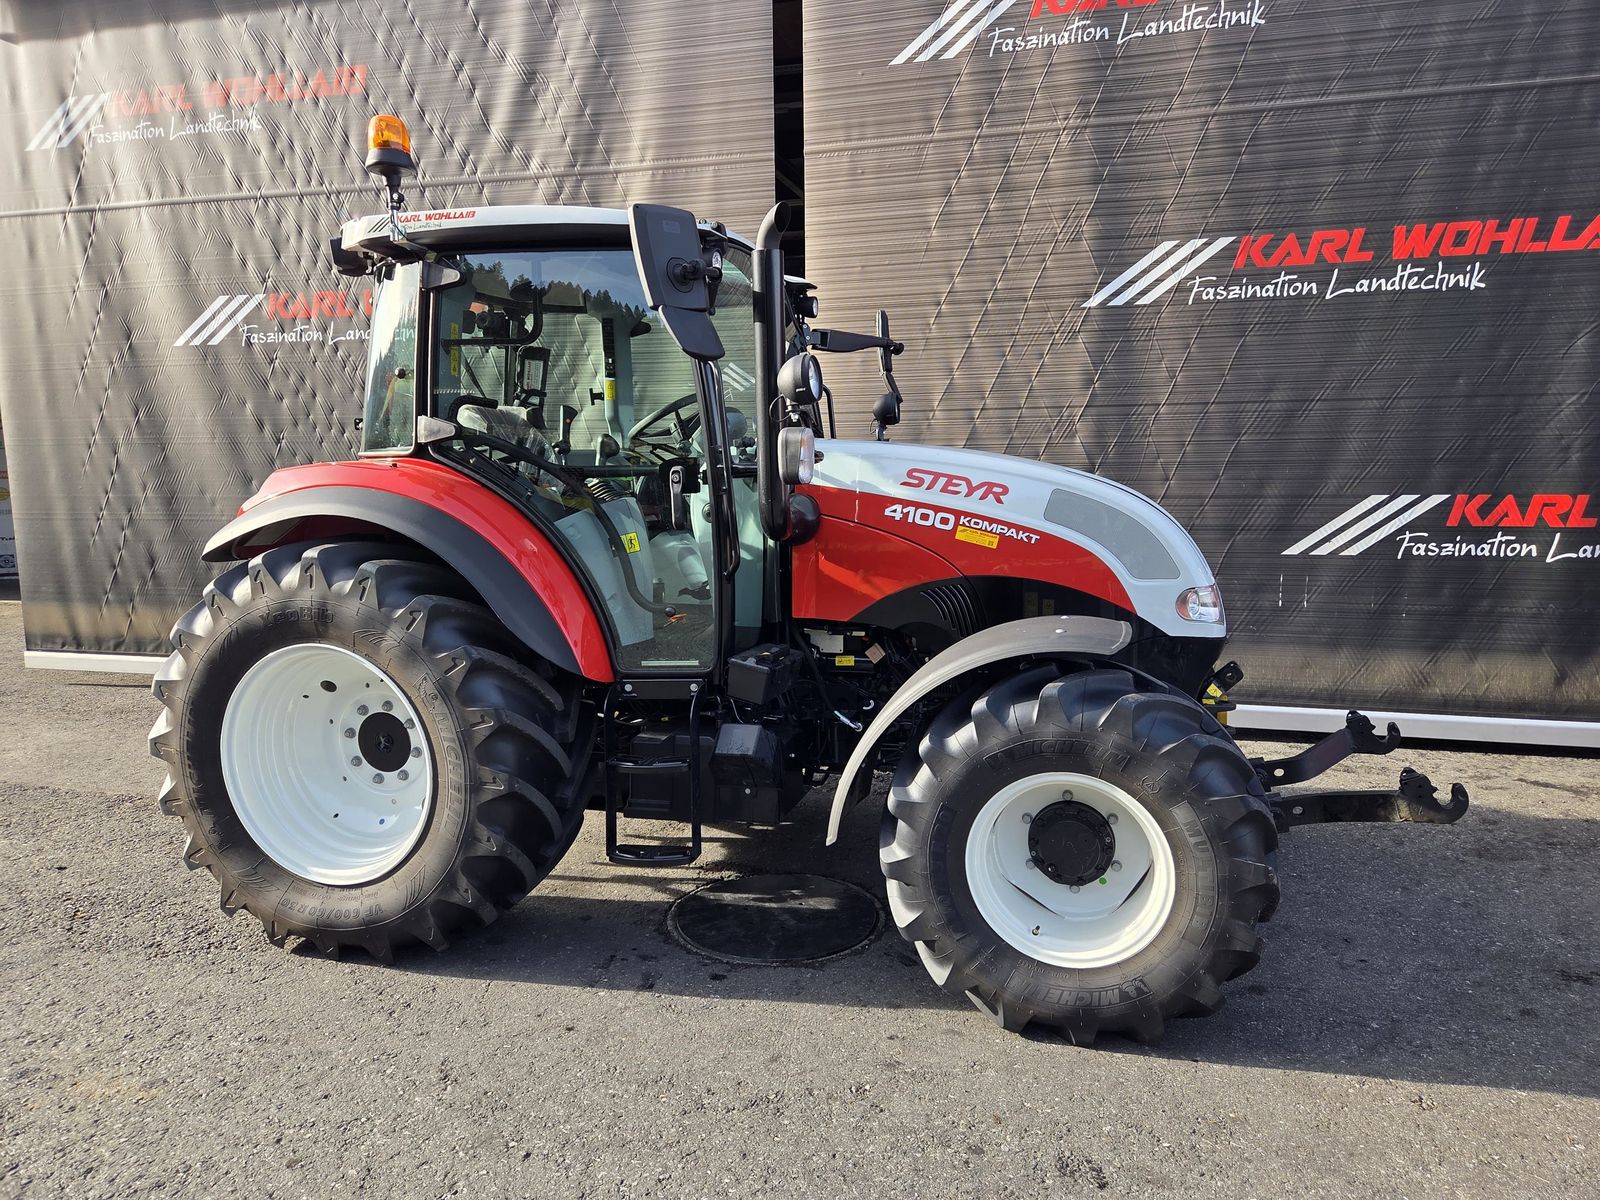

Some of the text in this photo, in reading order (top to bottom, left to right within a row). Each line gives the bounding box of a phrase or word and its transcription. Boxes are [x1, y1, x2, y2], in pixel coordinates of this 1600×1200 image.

[988, 16, 1109, 57] Faszination
[1117, 0, 1266, 44] Landtechnik
[104, 64, 369, 118] KARL WOHLLAIB
[87, 107, 262, 147] Faszination Landtechnik
[425, 210, 476, 221] WOHLLAIB
[1234, 228, 1374, 269] KARL
[1187, 261, 1486, 304] Faszination Landtechnik
[267, 289, 354, 320] KARL
[239, 323, 322, 346] Faszination
[899, 467, 1009, 505] STEYR
[884, 504, 1040, 544] 4100 KOMPAKT
[1445, 494, 1598, 527] KARL
[1396, 531, 1537, 560] Faszination
[434, 710, 464, 842] MICHELIN
